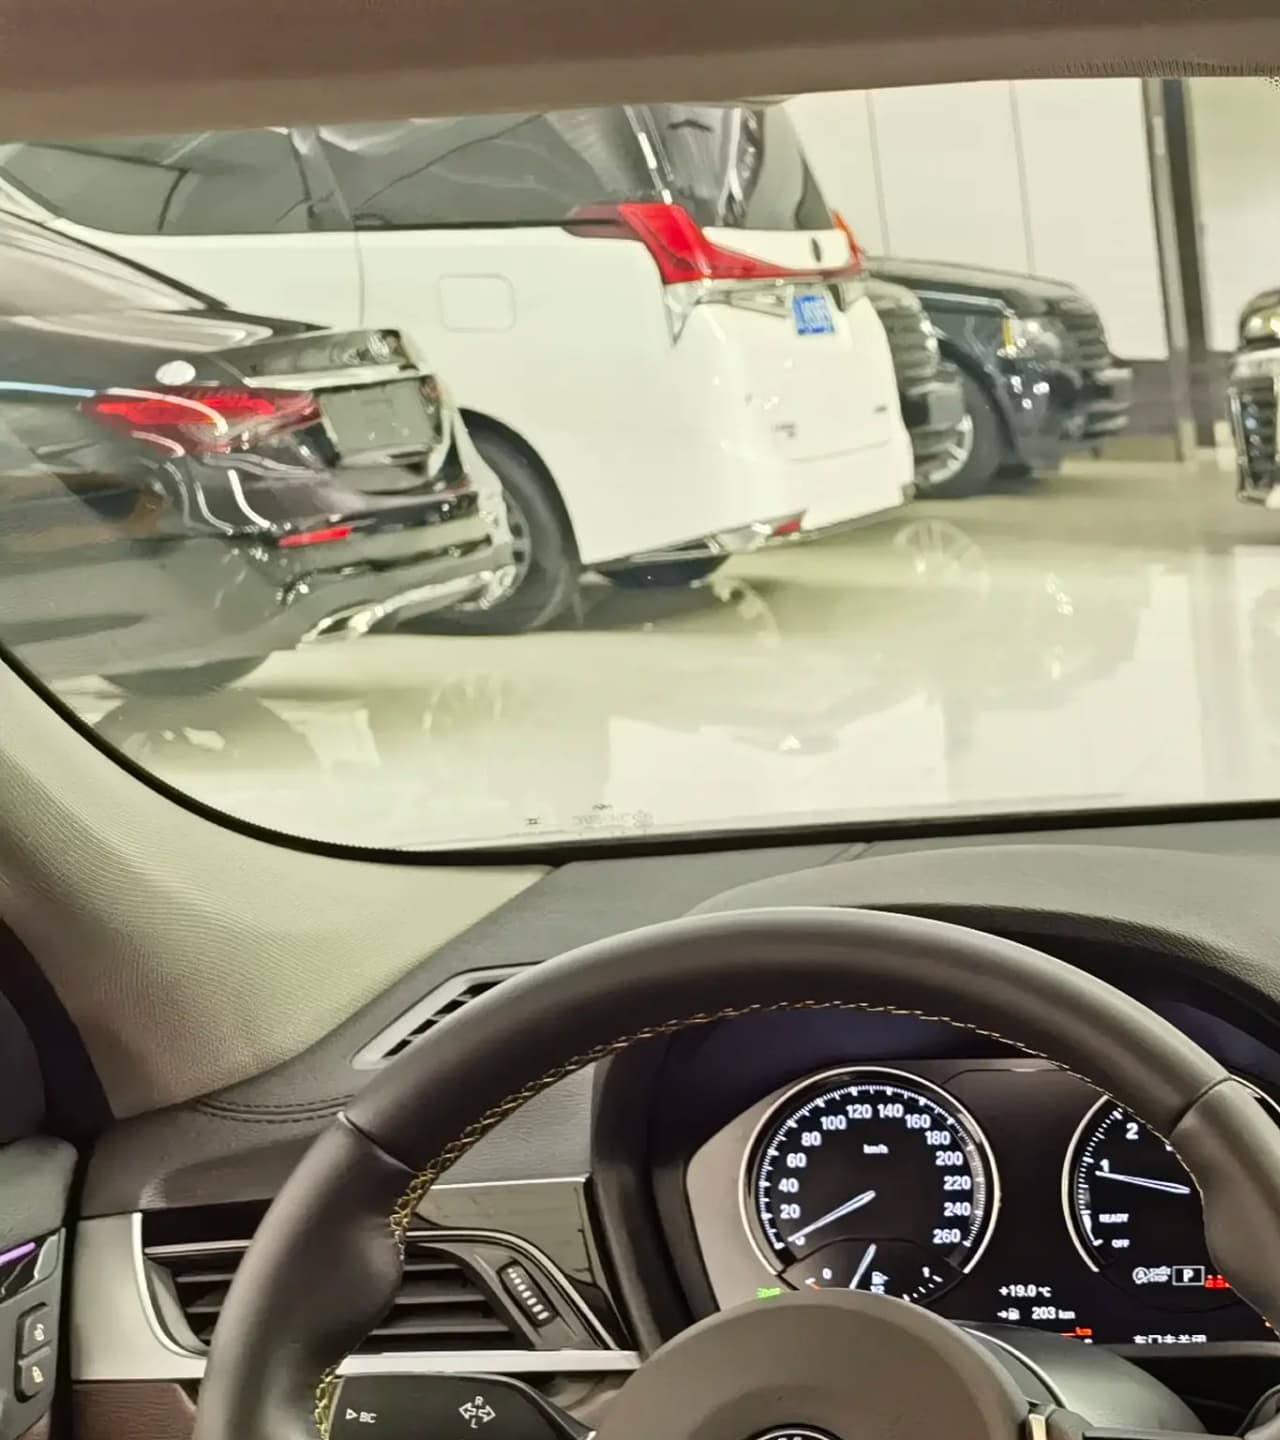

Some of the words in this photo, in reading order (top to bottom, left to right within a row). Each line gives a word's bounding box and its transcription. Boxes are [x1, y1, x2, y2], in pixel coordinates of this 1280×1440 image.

[846, 1103, 872, 1119] 120
[877, 1103, 904, 1118] 140
[820, 1115, 847, 1130] 100
[905, 1113, 931, 1129] 160
[925, 1130, 951, 1146] 180
[1125, 1122, 1139, 1140] 2
[801, 1131, 822, 1147] 80
[786, 1153, 807, 1168] 60
[935, 1150, 964, 1166] 200
[1099, 1158, 1110, 1173] 1
[778, 1177, 799, 1193] 40
[943, 1175, 972, 1190] 220
[780, 1203, 801, 1219] 20
[943, 1201, 972, 1217] 240
[1098, 1213, 1130, 1223] READY
[932, 1229, 961, 1244] 260
[1111, 1239, 1130, 1248] OFF
[1182, 1268, 1195, 1283] P
[999, 1284, 1036, 1298] +19.0
[1031, 1307, 1056, 1320] 203
[1058, 1309, 1076, 1320] km
[474, 1395, 484, 1406] R
[359, 1411, 377, 1423] BC
[470, 1418, 478, 1429] L
